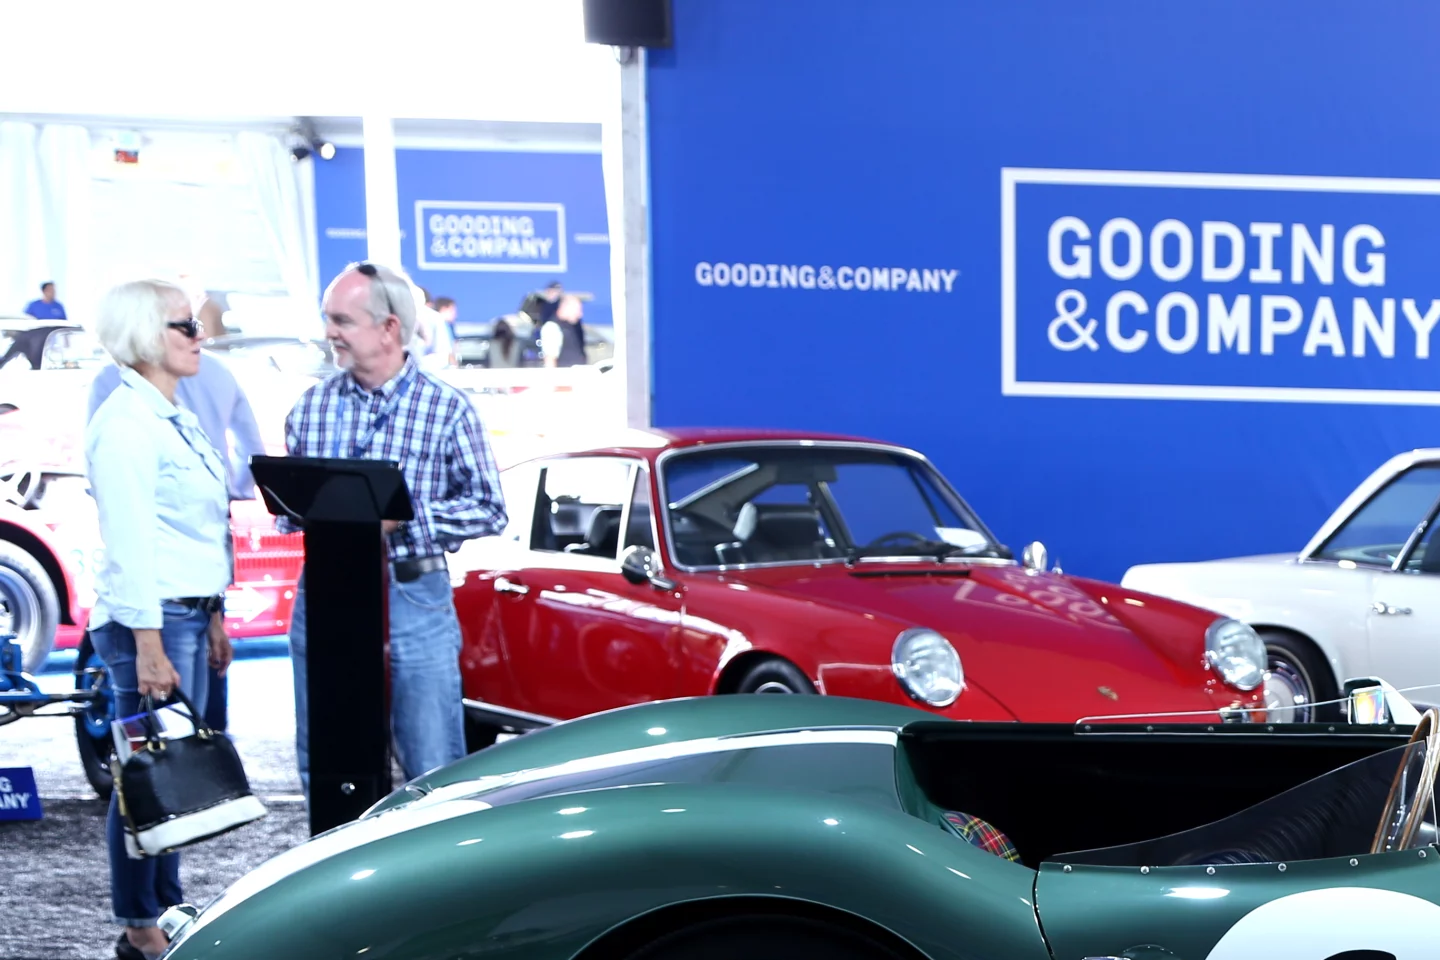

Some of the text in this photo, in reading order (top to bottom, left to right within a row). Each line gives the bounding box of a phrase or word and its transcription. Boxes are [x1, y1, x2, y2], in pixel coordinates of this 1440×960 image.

[429, 214, 535, 237] GOODING
[430, 235, 552, 259] &COMPANY
[1047, 215, 1386, 287] GOODING
[695, 261, 958, 293] GOODING&COMPANY
